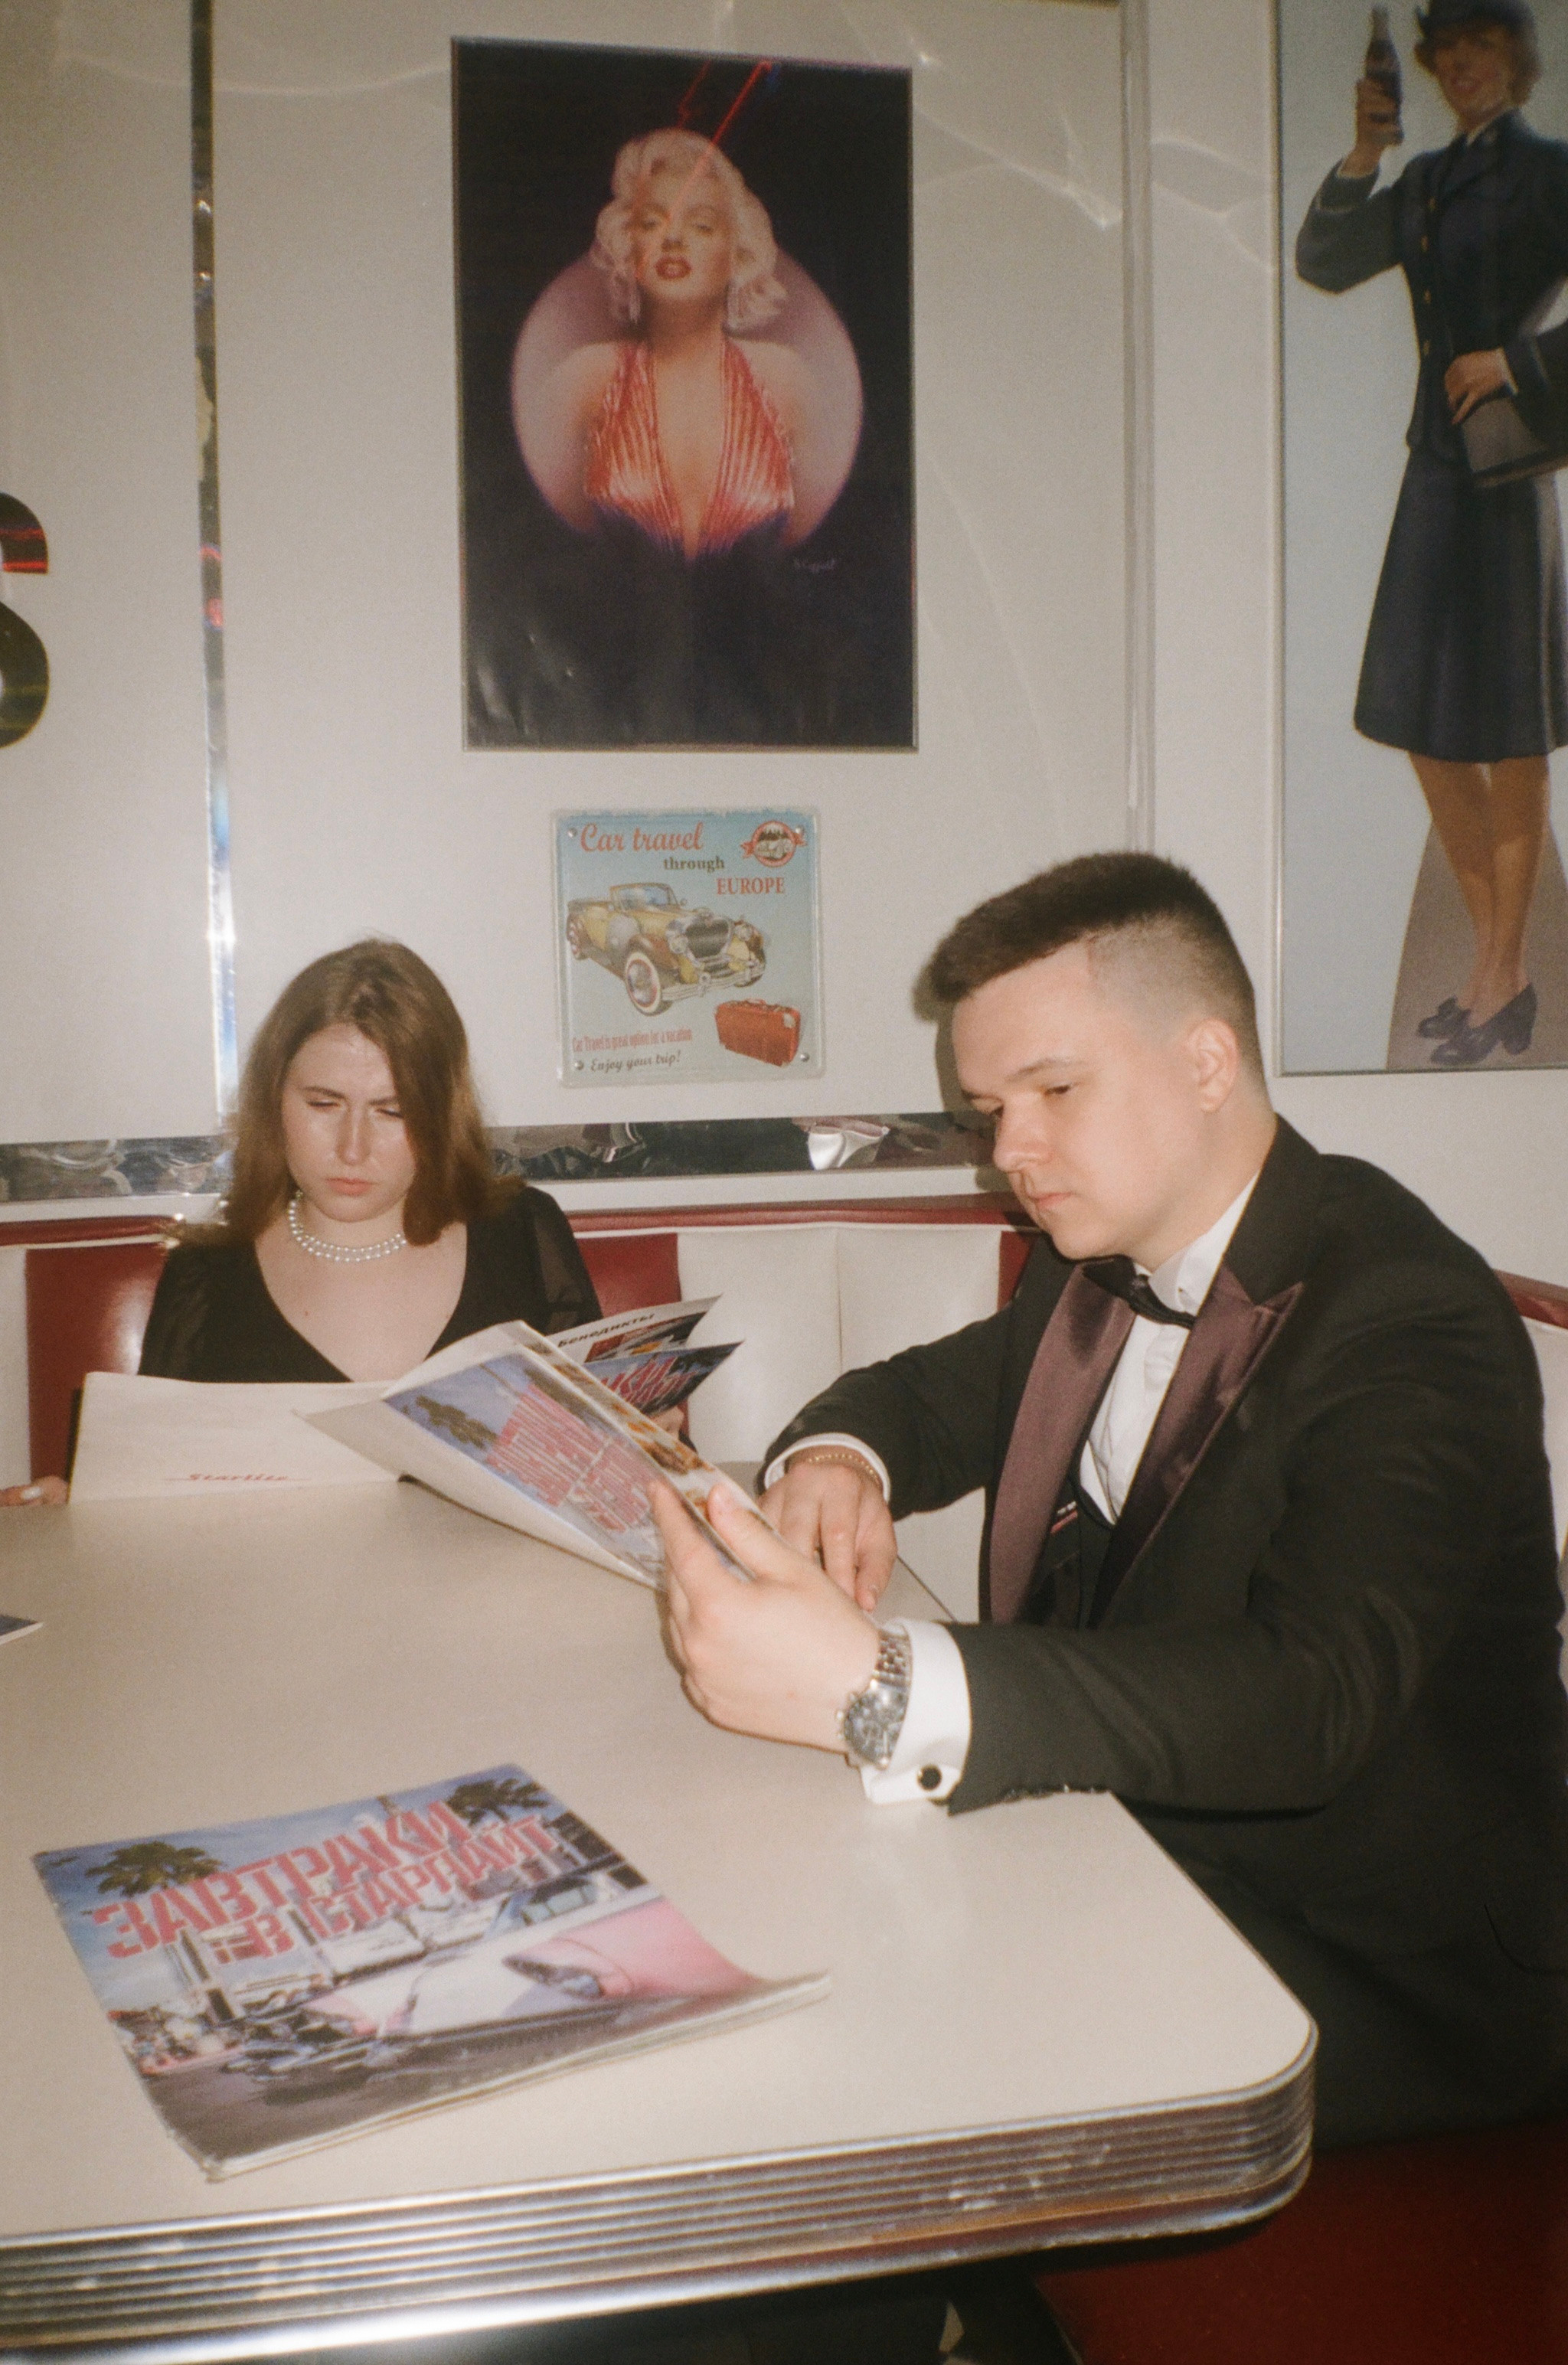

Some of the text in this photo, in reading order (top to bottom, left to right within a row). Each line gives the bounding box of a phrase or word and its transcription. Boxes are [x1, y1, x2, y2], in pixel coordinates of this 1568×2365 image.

[580, 822, 704, 852] Car travel
[663, 856, 725, 874] through
[717, 877, 786, 895] EUROPE
[590, 1048, 681, 1073] Enjoy your trip!
[92, 1800, 474, 1960] ЗАВТРАКИ
